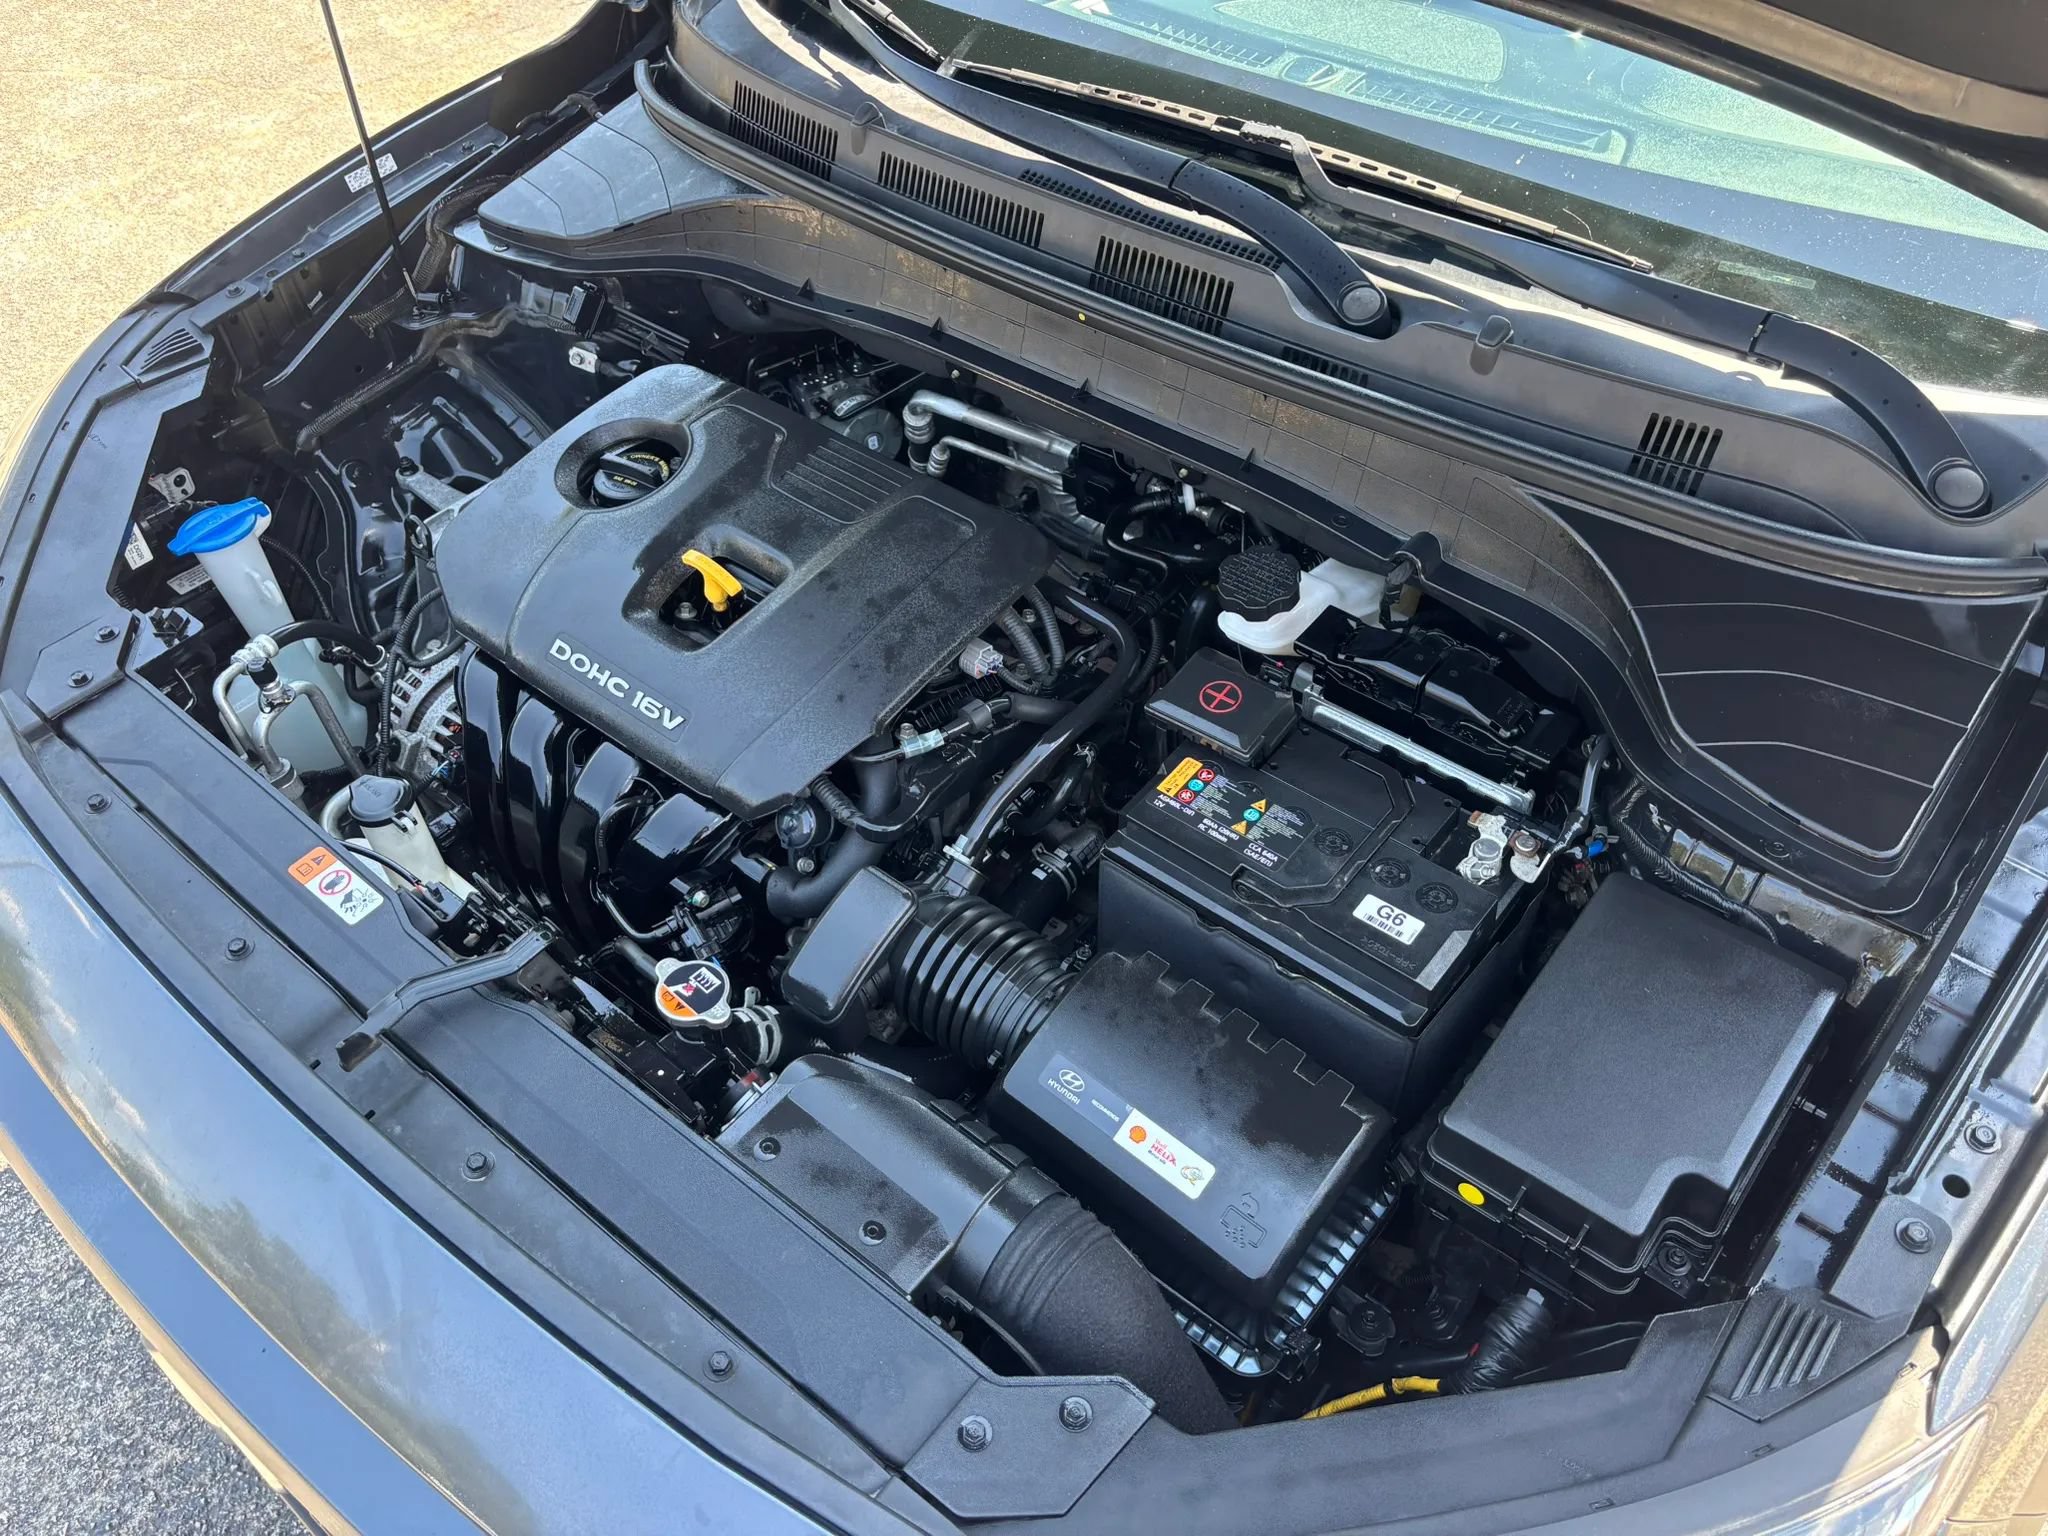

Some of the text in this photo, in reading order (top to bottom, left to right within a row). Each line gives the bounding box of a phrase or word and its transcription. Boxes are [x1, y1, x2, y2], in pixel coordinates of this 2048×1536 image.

[550, 639, 685, 730] DOHC 16V
[1153, 799, 1166, 808] 12V
[1197, 823, 1208, 832] RC
[1248, 842, 1262, 855] CCA
[1377, 905, 1407, 927] G6
[1048, 1078, 1081, 1105] HYUNDAI
[1151, 1144, 1177, 1167] HELIX
